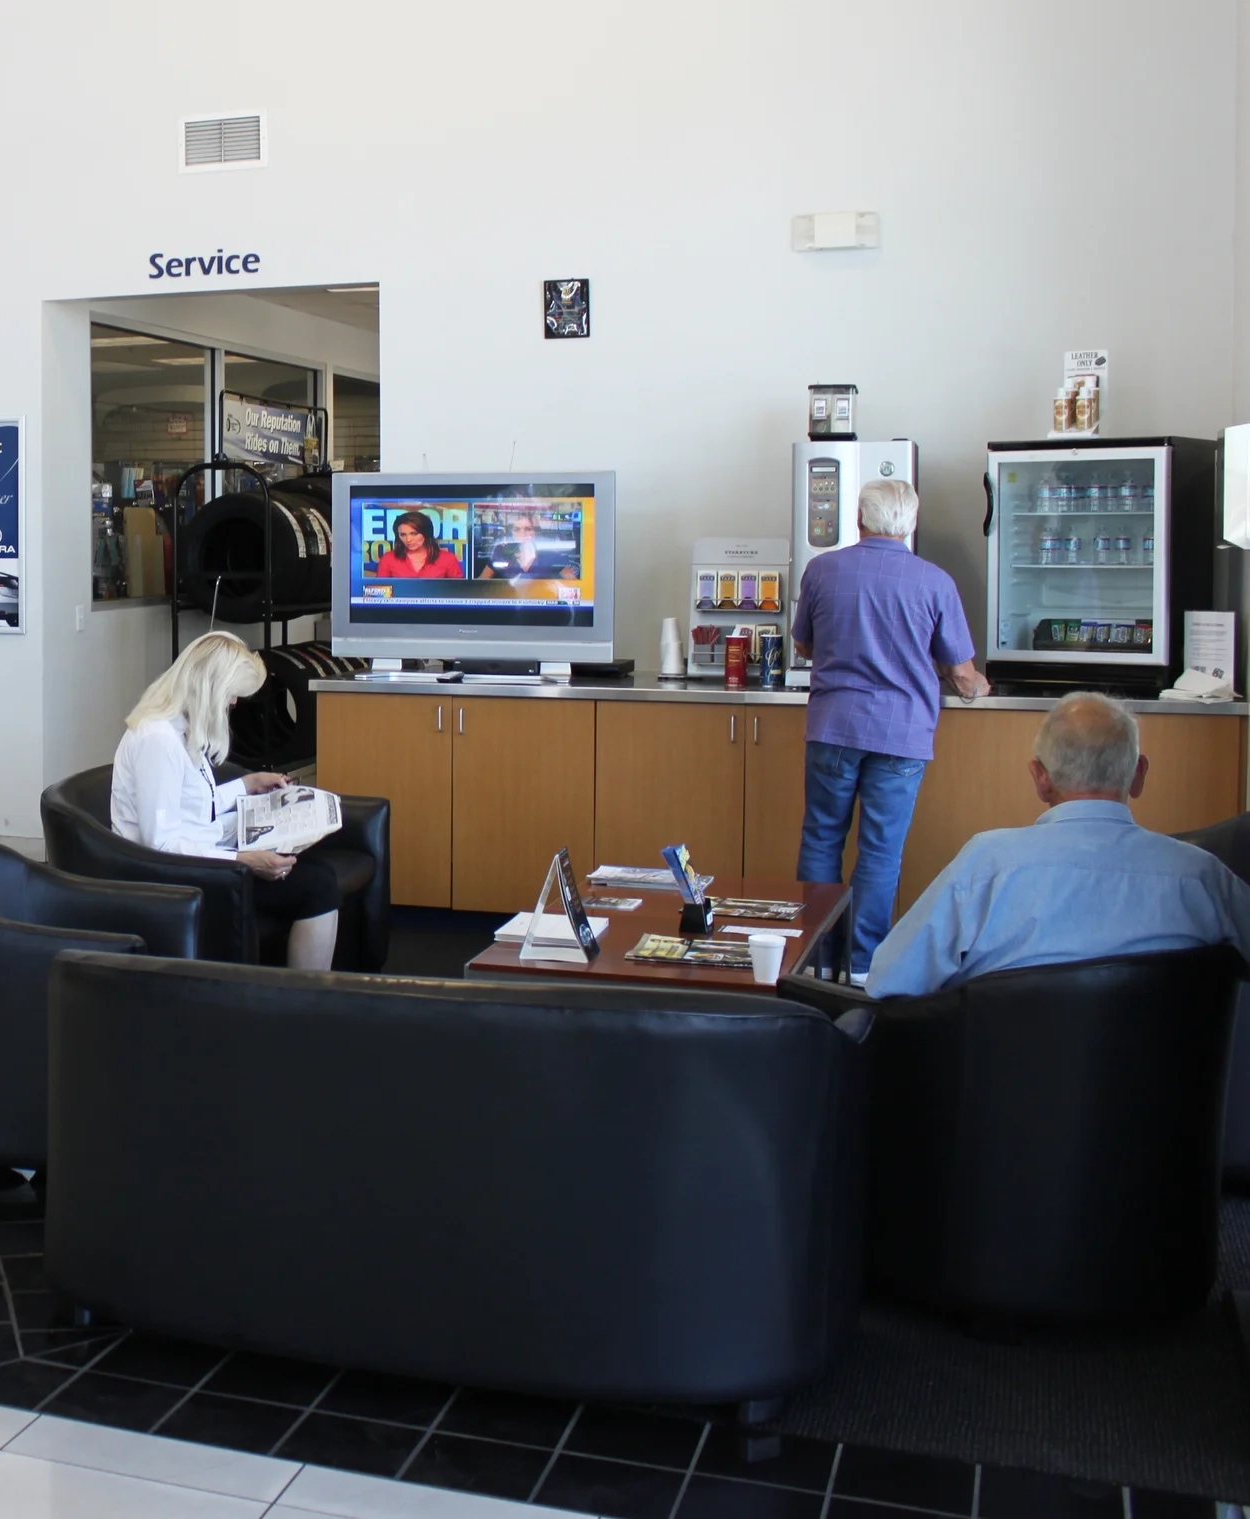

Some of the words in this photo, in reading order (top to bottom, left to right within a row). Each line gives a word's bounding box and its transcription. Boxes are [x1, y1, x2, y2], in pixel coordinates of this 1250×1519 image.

[148, 248, 261, 279] Service
[1071, 352, 1099, 360] LEATHER
[245, 407, 259, 427] Our
[261, 410, 301, 434] Reputation
[245, 431, 267, 452] Rides
[268, 439, 279, 453] on
